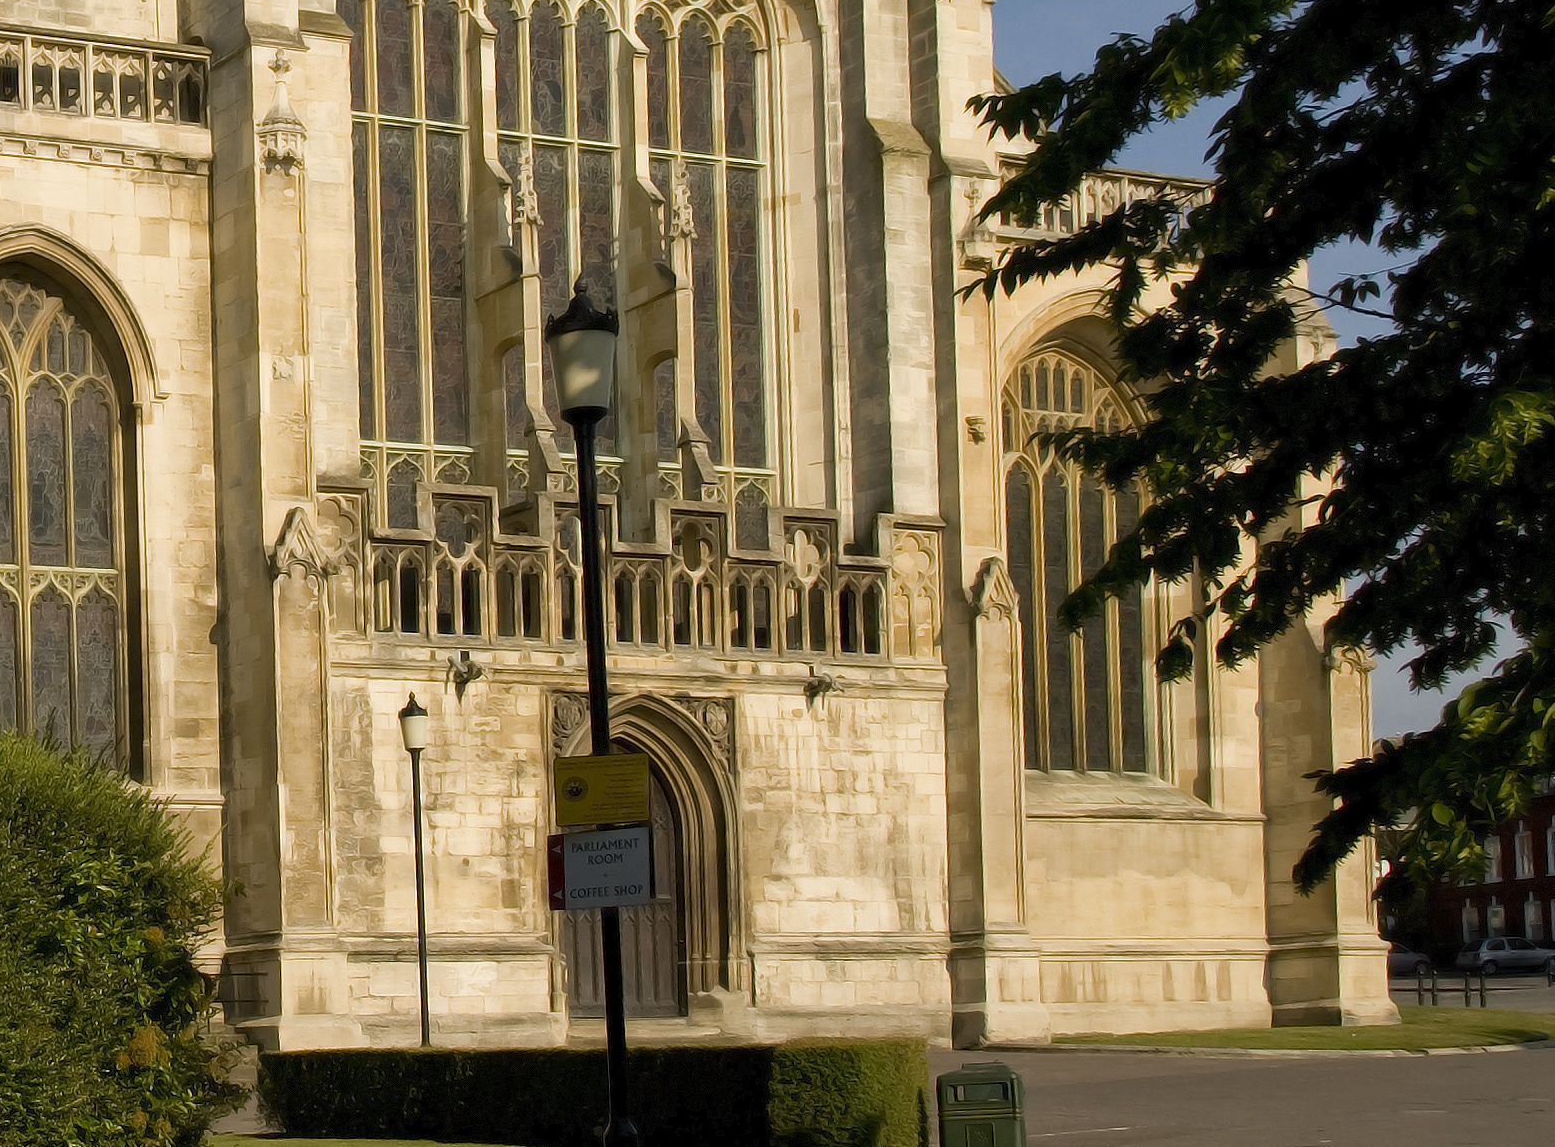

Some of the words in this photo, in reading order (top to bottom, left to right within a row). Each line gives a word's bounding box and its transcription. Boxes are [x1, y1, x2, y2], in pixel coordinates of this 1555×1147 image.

[571, 838, 639, 853] PARLIAMENT
[588, 853, 623, 865] ROOM
[570, 886, 610, 899] COFFEE
[614, 884, 644, 896] SHOP
